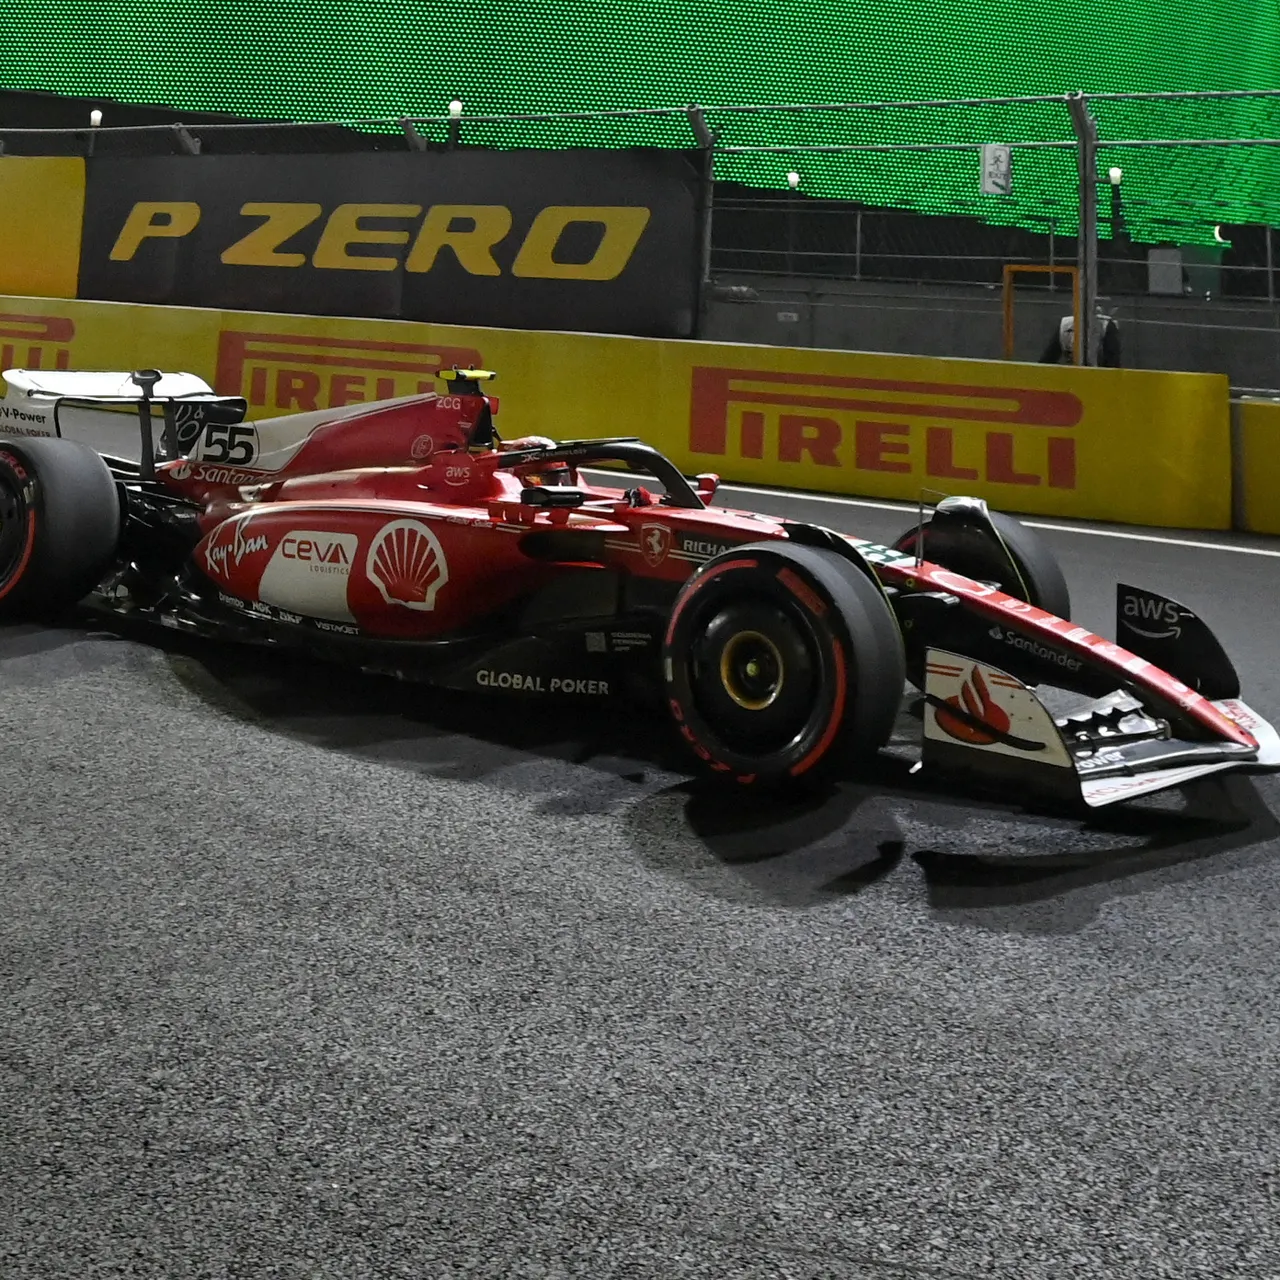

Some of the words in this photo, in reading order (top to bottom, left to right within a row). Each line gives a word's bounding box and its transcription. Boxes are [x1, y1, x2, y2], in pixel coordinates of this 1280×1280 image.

[110, 202, 200, 261] P
[221, 202, 651, 281] ZERO
[436, 396, 461, 410] ZCG
[0, 406, 46, 425] V-Power
[202, 424, 255, 466] 55
[689, 366, 1084, 507] PIRELLI
[446, 467, 470, 480] aws
[683, 539, 732, 556] RICHA
[310, 565, 349, 575] LOGISTICS
[219, 592, 245, 608] brembo
[252, 600, 272, 614] NGK
[1123, 595, 1179, 623] aws
[1004, 631, 1083, 671] Santander
[476, 670, 545, 692] GLOBAL
[550, 678, 609, 695] POKER
